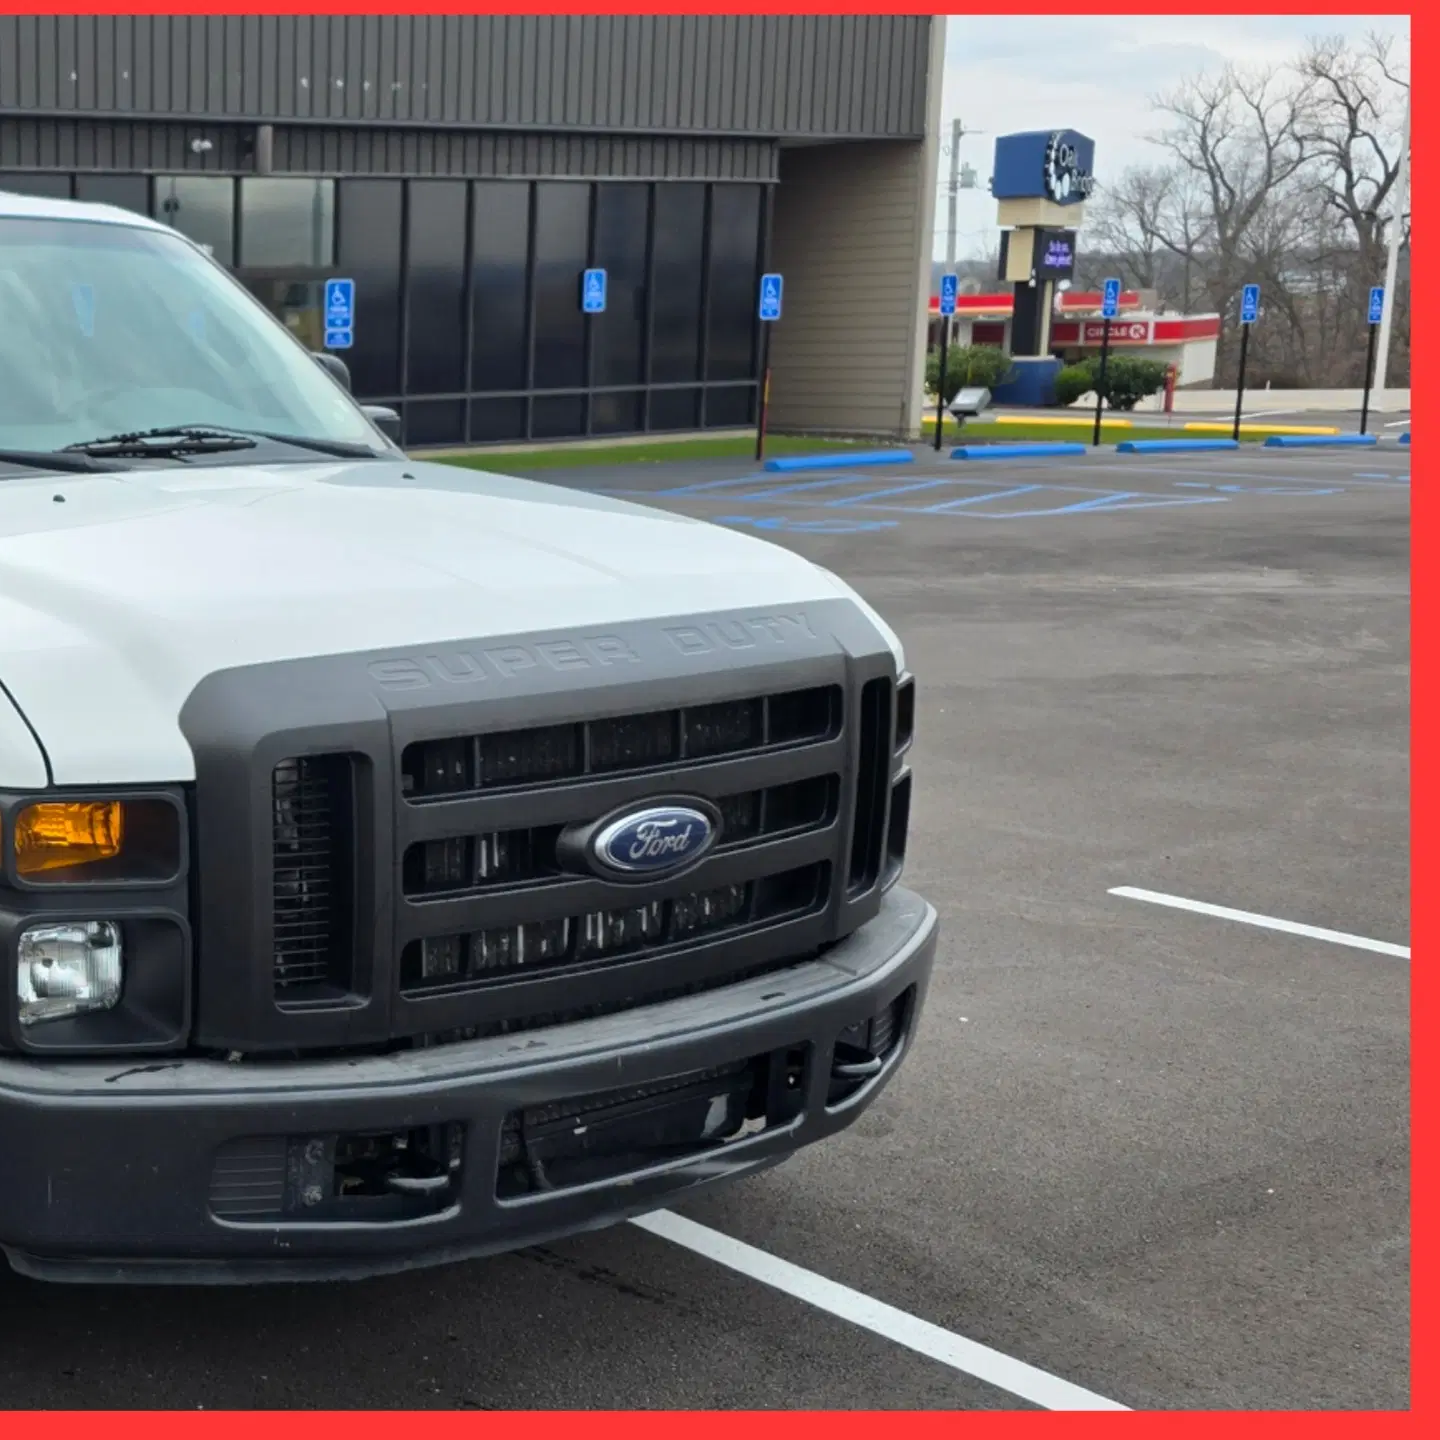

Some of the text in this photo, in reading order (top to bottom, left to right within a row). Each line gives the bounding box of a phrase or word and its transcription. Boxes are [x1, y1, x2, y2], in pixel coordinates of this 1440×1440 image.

[366, 611, 819, 692] SUPER DUTY
[628, 818, 691, 861] Ford
